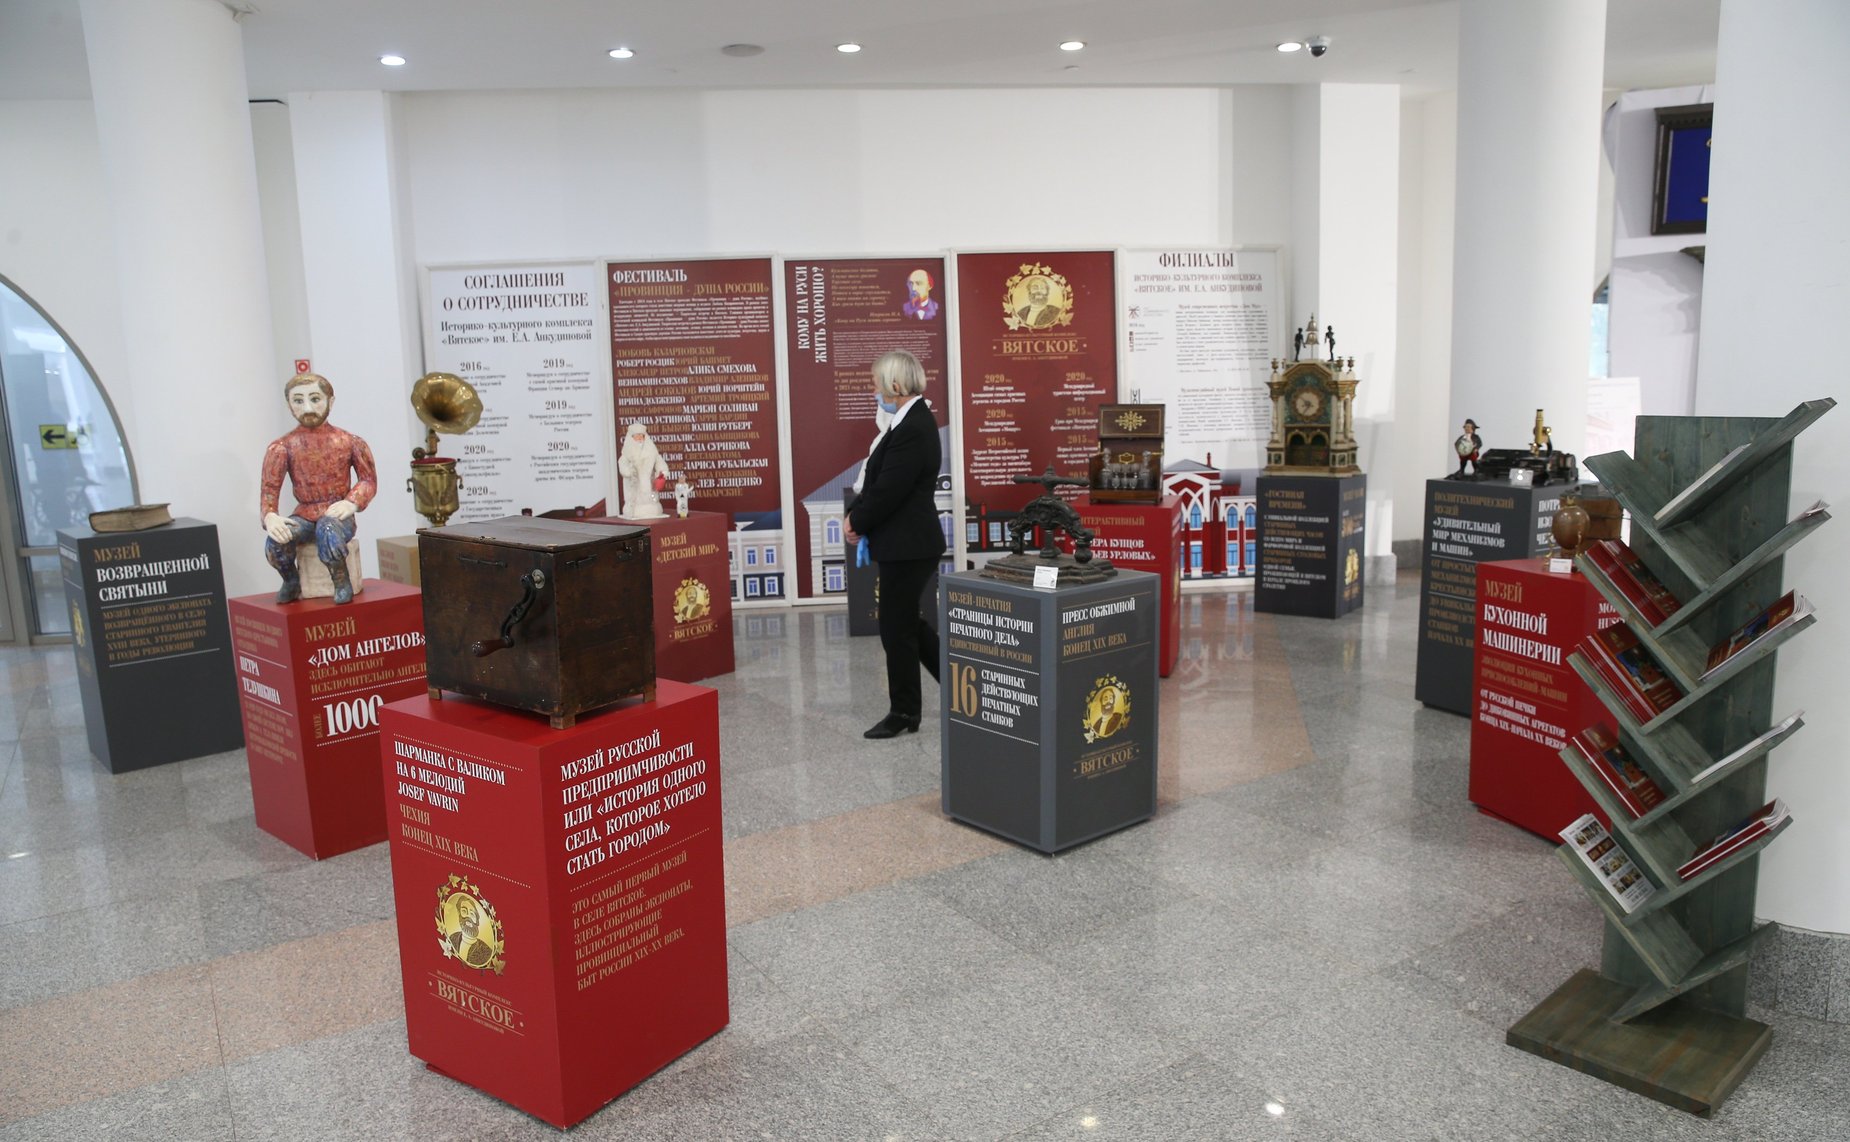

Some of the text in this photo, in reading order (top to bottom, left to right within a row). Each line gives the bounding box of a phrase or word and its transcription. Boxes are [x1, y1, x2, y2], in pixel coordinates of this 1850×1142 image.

[1159, 253, 1234, 267] ФИЛИАЛЫ
[464, 272, 564, 290] СОГЛАШЕНИЯ
[613, 269, 687, 284] ФЕСТИВАЛЬ
[615, 283, 769, 297] «ПРОВИНЦИЯ ДУША РОССИИ»
[443, 292, 589, 312] О СОТРУДНИЧЕСТВЕ
[796, 266, 810, 349] КОМУ НА РУСИ
[812, 267, 827, 363] ЖИТЬ ХОРОШО?
[1003, 340, 1078, 353] ВЯТСКОЕ
[460, 362, 482, 371] 2016
[543, 359, 565, 368] 2019
[617, 359, 644, 367] РОБЕРТ
[688, 364, 757, 374] АЛИКА СМЕХОВА
[985, 374, 1005, 383] 2020
[545, 400, 567, 410] 2019
[986, 409, 1006, 418] 2020
[655, 415, 696, 423] УСТИНОВА
[692, 422, 752, 431] ЮЛИЯ РУТБЕРГ
[464, 445, 486, 454] 2020
[548, 442, 569, 452] 2020
[684, 441, 750, 452] АЛЛА СУРИКОВА
[986, 437, 1006, 447] 2015
[684, 459, 768, 469] ЛАРИСА РУБАЛЬСКАЯ
[467, 487, 488, 496] 2020
[697, 477, 762, 488] ЛЕВ ЛЕЩЕНКО
[1080, 516, 1144, 526] НТЕРАКТИВНЫЙ
[1433, 517, 1501, 534] «УДИВИТЕЛЬНЫЙ
[660, 532, 687, 547] МУЗЕЙ
[1110, 539, 1144, 549] КУПЦОВ
[1432, 542, 1473, 556] И МАШИН»
[1433, 530, 1505, 548] МИР МЕХАНИЗМОВ
[94, 543, 141, 563] МУЗЕЙ
[656, 544, 719, 563] «ДЕТСКИЙ МИР»
[96, 554, 210, 582] ВОЗВРАЩЕННОЙ
[99, 580, 167, 602] СВЯТЫНИ
[1485, 580, 1522, 604] МУЗЕЙ
[948, 608, 1033, 633] «СТРАНИЦЫ ИСТОРИИ
[1063, 597, 1135, 624] ПРЕСС ОБЖИМНОЙ
[1484, 605, 1547, 635] КУХОННОЙ
[305, 617, 356, 642] МУЗЕЙ
[674, 623, 714, 639] ВЯТСКОЕ
[950, 623, 1019, 646] ПЕЧАТНОГО ДЕЛА»
[1063, 624, 1094, 640] АНГЛИЯ
[308, 632, 426, 668] «ДОМ АНГЕЛОВ»
[1063, 633, 1127, 656] КОНЕЦ XIX ВЕКА
[1482, 629, 1561, 665] МАШИНЕРИИ
[309, 658, 384, 680] ЗДЕСЬ ОБИТАЮТ
[311, 670, 395, 694] ИСКЛЮЧИТЕЛЬНО
[949, 662, 977, 717] 16
[981, 670, 1026, 689] СТАРИННЫХ
[981, 683, 1038, 706] ДЕЙСТВУЮЩИХ
[982, 697, 1020, 716] ПЕЧАТНЫХ
[982, 711, 1013, 728] СТАНКОВ
[394, 741, 505, 785] ШАРМАНКА С ВАЛИКОМ
[561, 729, 661, 781] МУЗЕЙ РУССКОЙ
[1081, 747, 1134, 773] ВЯТСКОЕ
[396, 761, 465, 794] НА 6 МЕЛОДИЙ
[562, 742, 693, 805] ПРЕДПРИИМЧИВОСТИ
[398, 782, 459, 812] JOSEF VAVRIN
[564, 760, 706, 829] ИЛИ «ИСТОРИЯ ОДНОГО
[400, 804, 430, 825] ЧЕХИЯ
[566, 781, 706, 851] СЕЛА, КОТОРОЕ ХОТЕЛО
[402, 824, 478, 862] КОНЕЦ XIX ВЕКА
[567, 820, 670, 875] СТАТЬ ГОРОДОМ»
[572, 851, 687, 914] ЭТО САМЫЙ ПЕРВЫЙ МУЗЕЙ
[574, 918, 580, 929] В
[582, 906, 605, 924] СЕЛЕ
[574, 926, 602, 945] ЗДЕСЬ
[604, 905, 643, 931] СОБРАНЫ
[576, 909, 662, 960] ИЛЛЮСТРИРУЮЩИЕ
[576, 924, 659, 976] ПРОВИНЦИАЛЬНЫЙ
[578, 973, 597, 991] БЫТ
[600, 956, 632, 980] РОССИИ
[438, 980, 514, 1028] ВЯТСКОЕ
